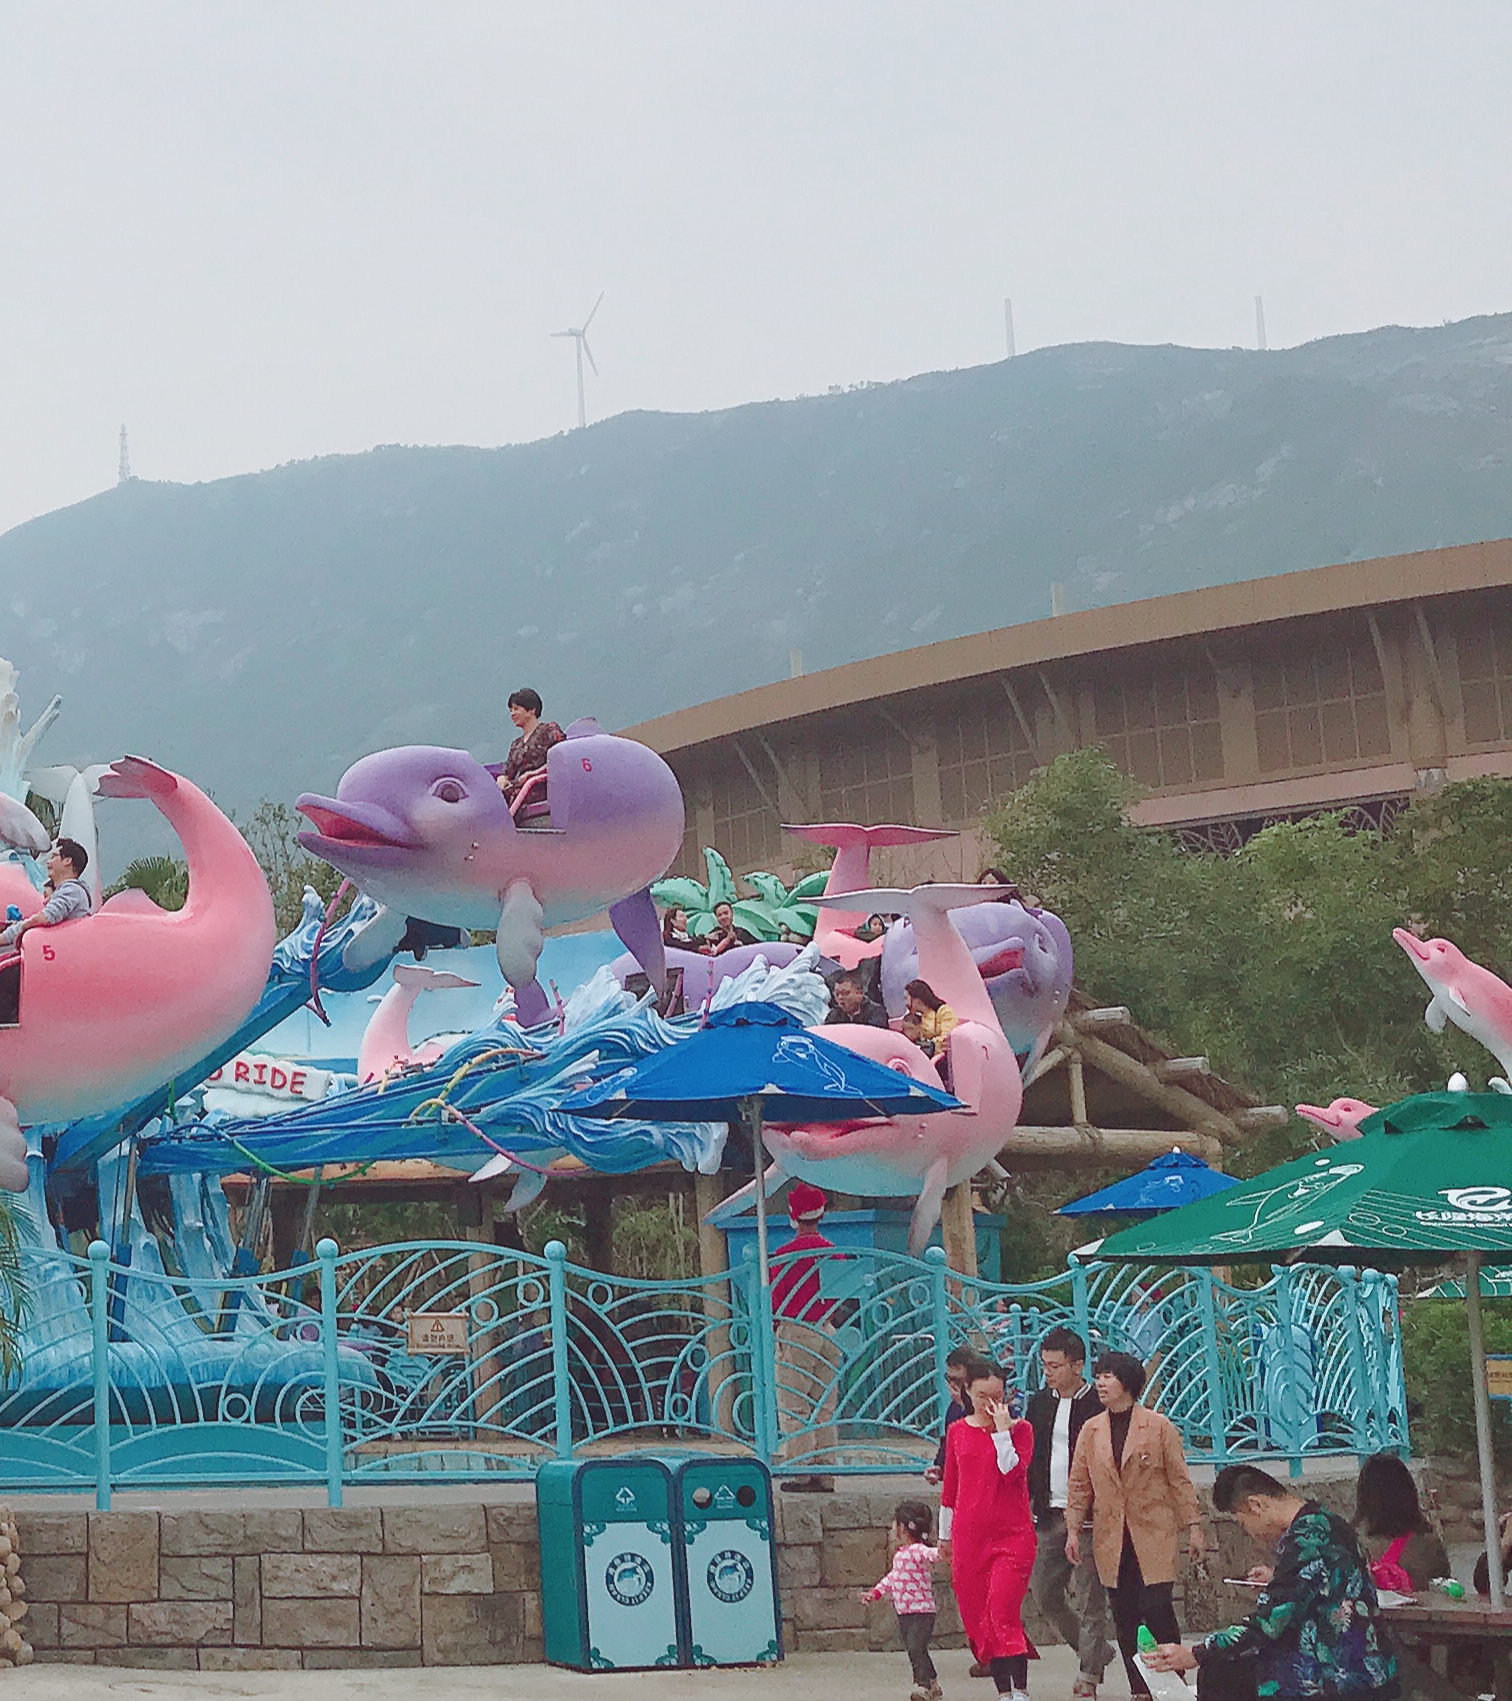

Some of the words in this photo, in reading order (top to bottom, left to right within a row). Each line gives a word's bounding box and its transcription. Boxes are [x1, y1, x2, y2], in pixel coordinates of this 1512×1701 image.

[581, 757, 593, 773] 6
[42, 944, 56, 962] 5
[234, 1060, 307, 1095] RIDE
